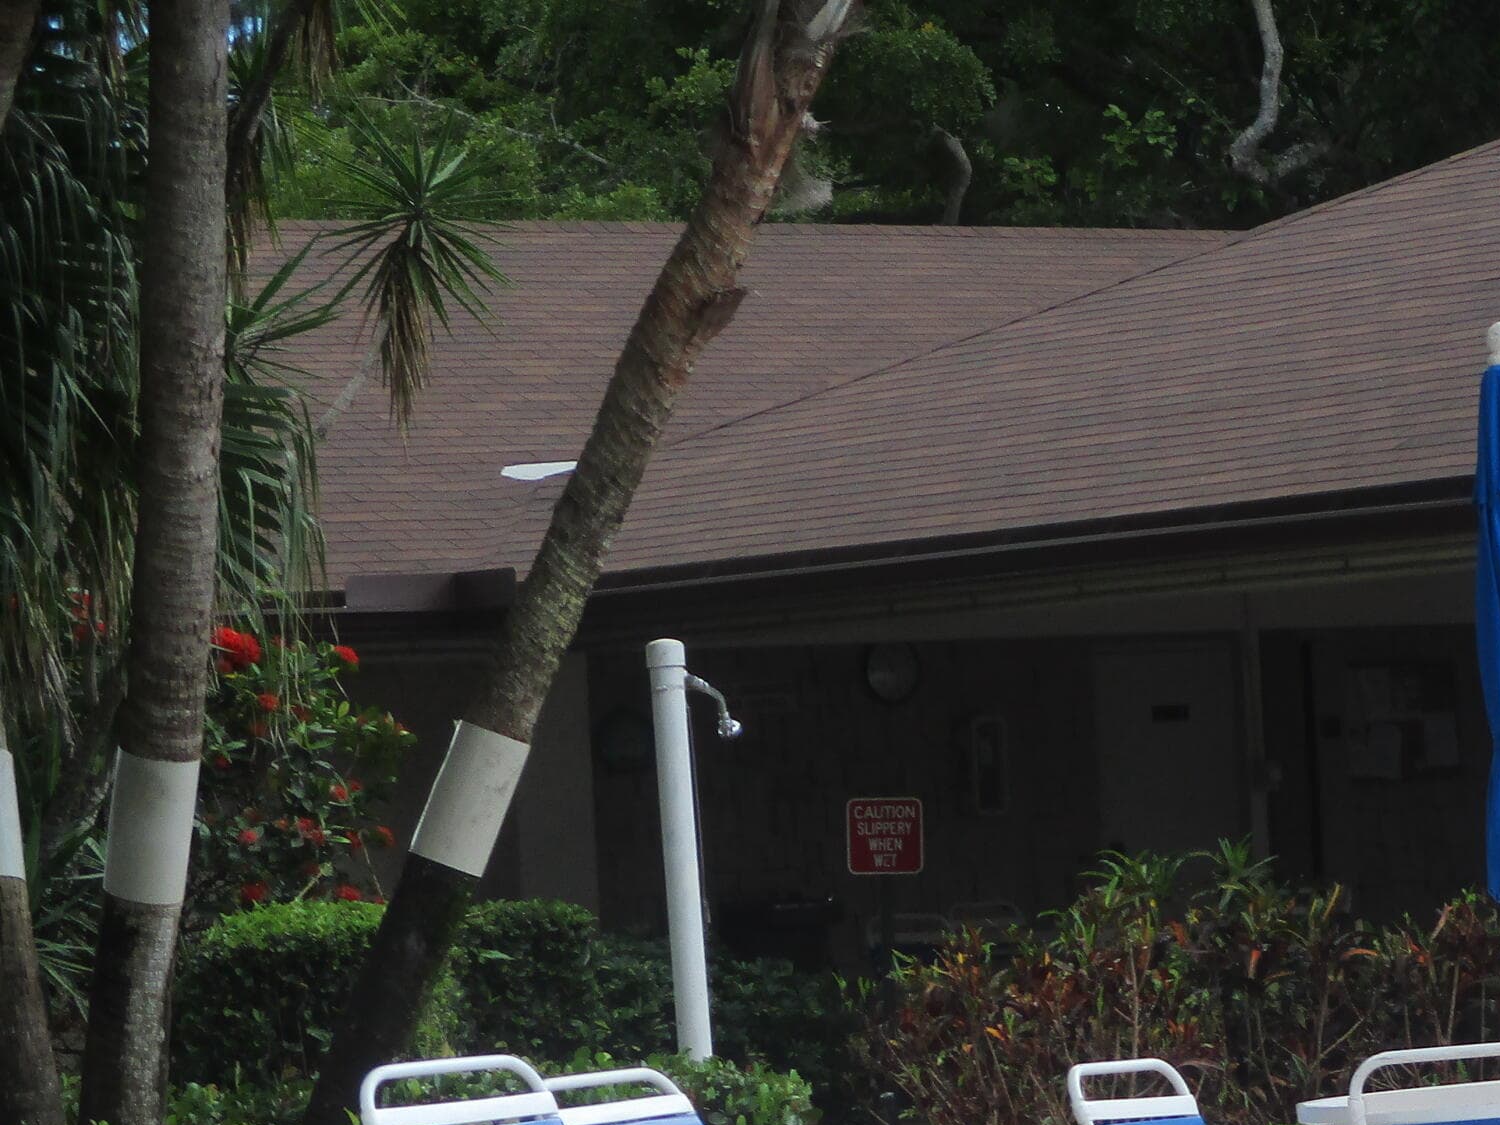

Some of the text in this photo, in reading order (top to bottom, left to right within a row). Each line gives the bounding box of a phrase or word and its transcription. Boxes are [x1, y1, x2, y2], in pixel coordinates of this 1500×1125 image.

[854, 805, 916, 819] CAUTION
[857, 821, 912, 836] SLIPPERY
[868, 837, 903, 851] WHEN
[873, 853, 897, 867] WET
